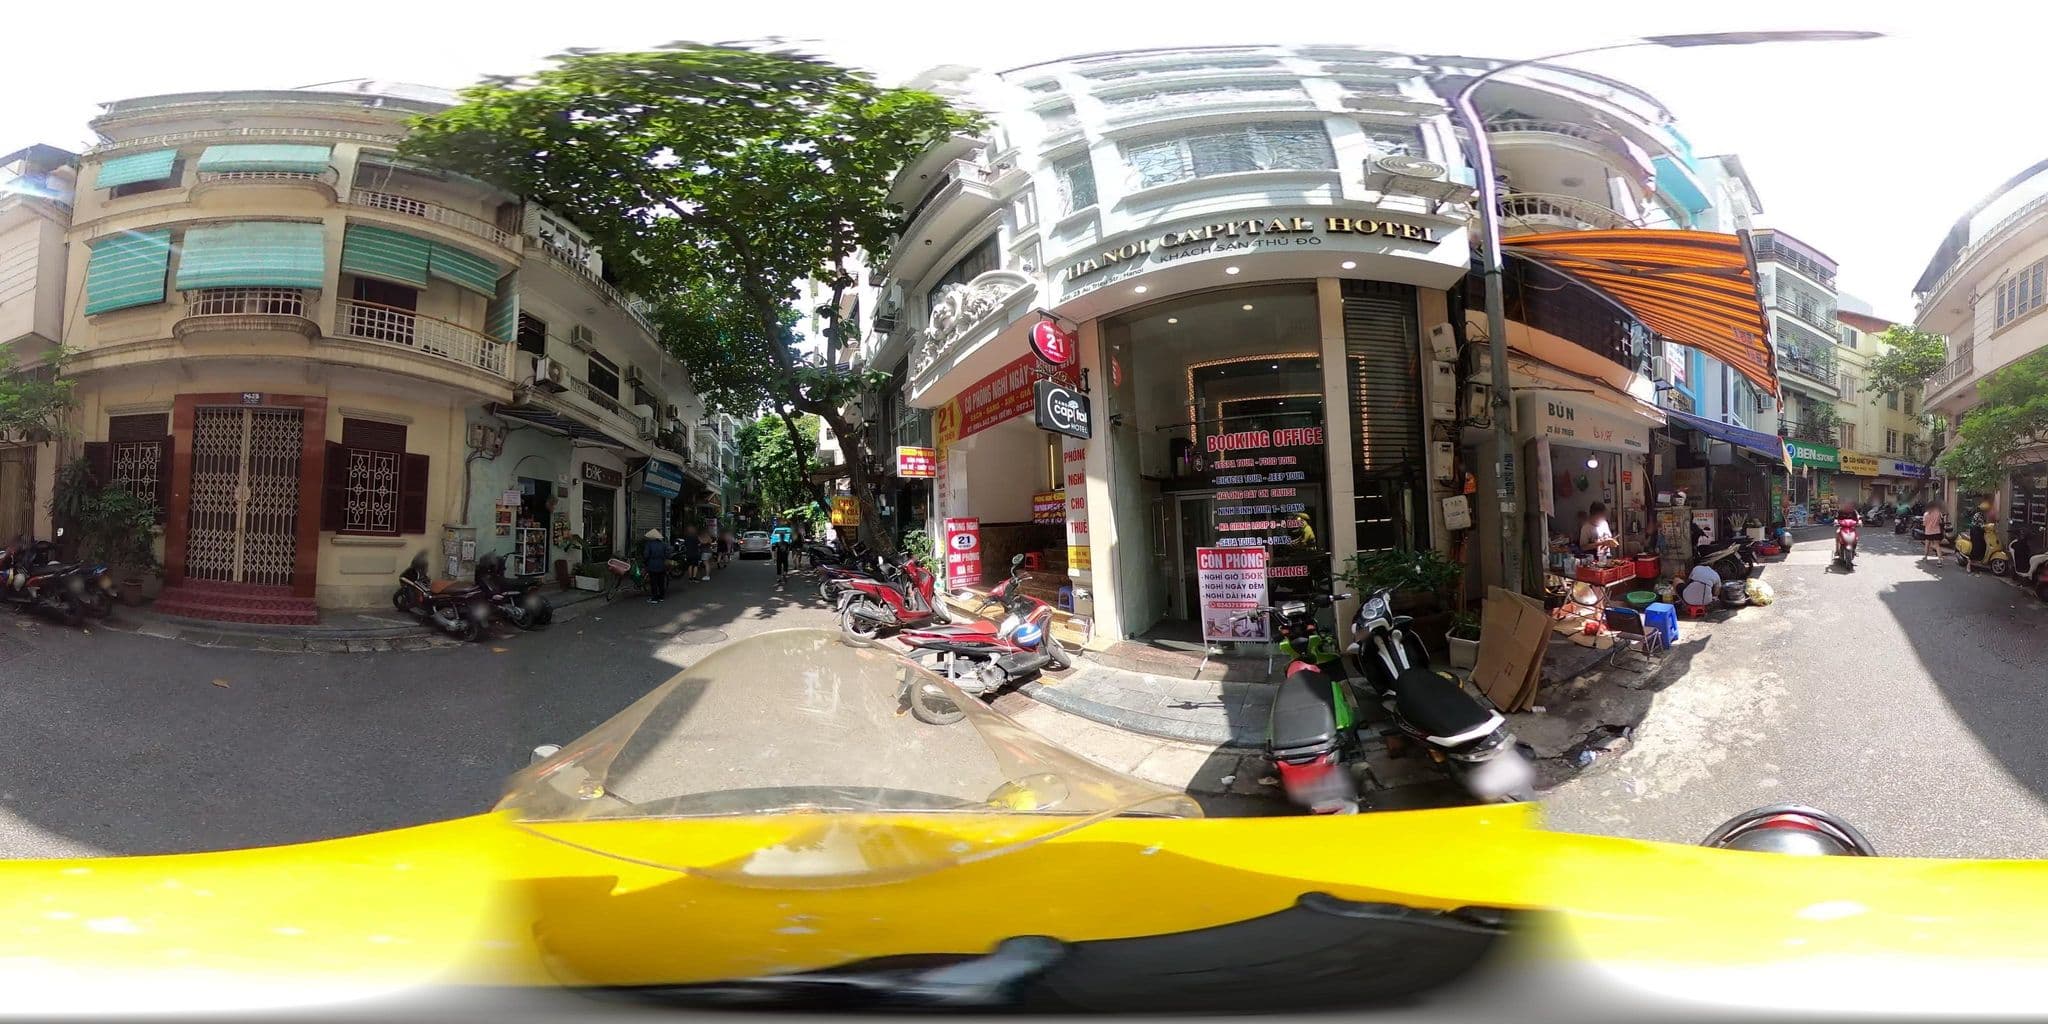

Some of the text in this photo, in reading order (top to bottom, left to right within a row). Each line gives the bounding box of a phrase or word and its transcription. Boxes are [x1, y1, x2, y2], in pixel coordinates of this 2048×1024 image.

[1066, 216, 1441, 281] HANOI CAPITAL HOTEL
[1046, 332, 1064, 353] 21
[938, 402, 956, 434] 21
[1547, 400, 1575, 421] BÚN
[1207, 426, 1324, 452] BOOKING OFFICE
[1236, 459, 1255, 468] TOUR
[1278, 456, 1297, 465] TOUR
[1244, 474, 1262, 484] TOUR
[1267, 472, 1285, 482] JEEP
[1285, 471, 1305, 481] TOUR
[1070, 497, 1085, 510] CHO
[958, 536, 971, 545] 21
[1200, 549, 1264, 568] CÒN PHÒNG
